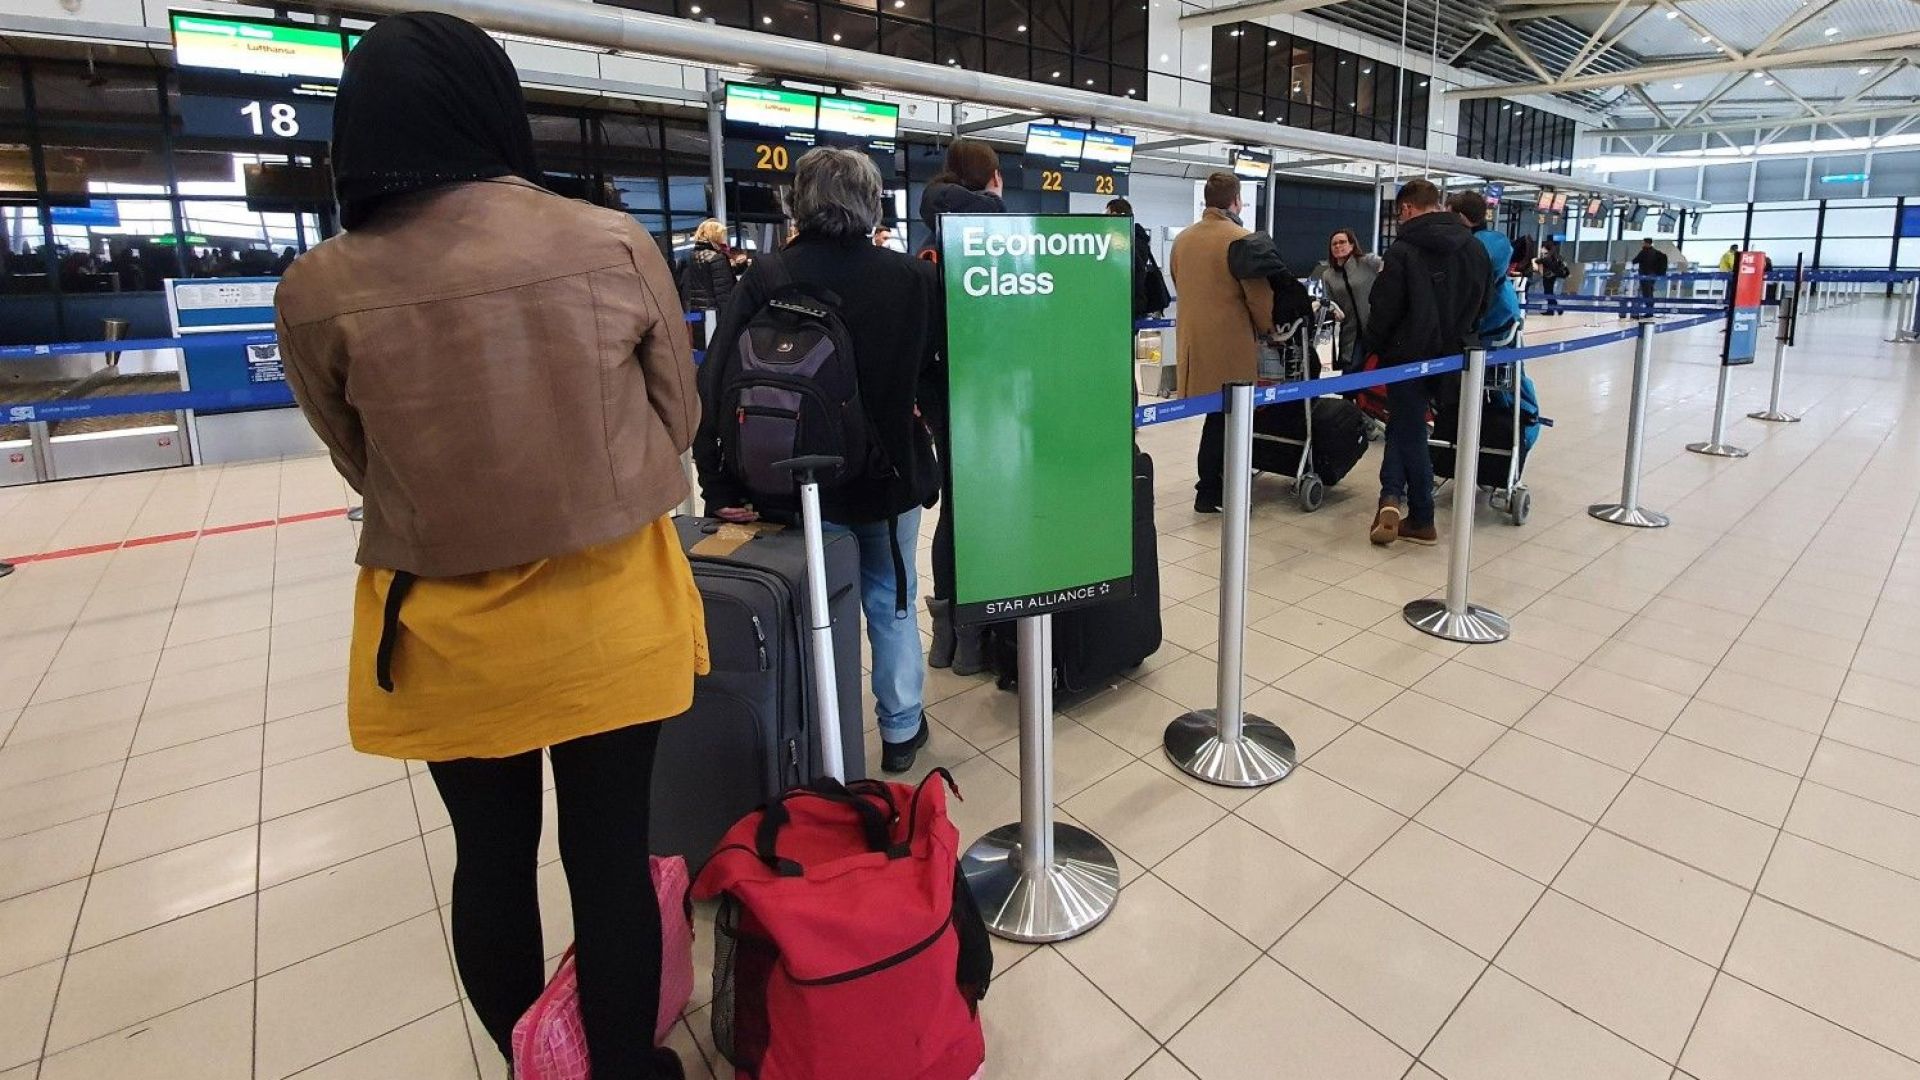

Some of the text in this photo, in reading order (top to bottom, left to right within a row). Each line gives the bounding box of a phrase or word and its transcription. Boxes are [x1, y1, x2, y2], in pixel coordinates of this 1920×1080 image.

[247, 43, 296, 55] Lufthansa
[240, 101, 299, 137] 18
[756, 145, 789, 170] 20
[1042, 171, 1062, 191] 22
[1096, 175, 1114, 194] 23
[962, 226, 1112, 261] Economy
[963, 266, 1054, 297] Class
[986, 586, 1096, 614] STAR ALLIANCE
